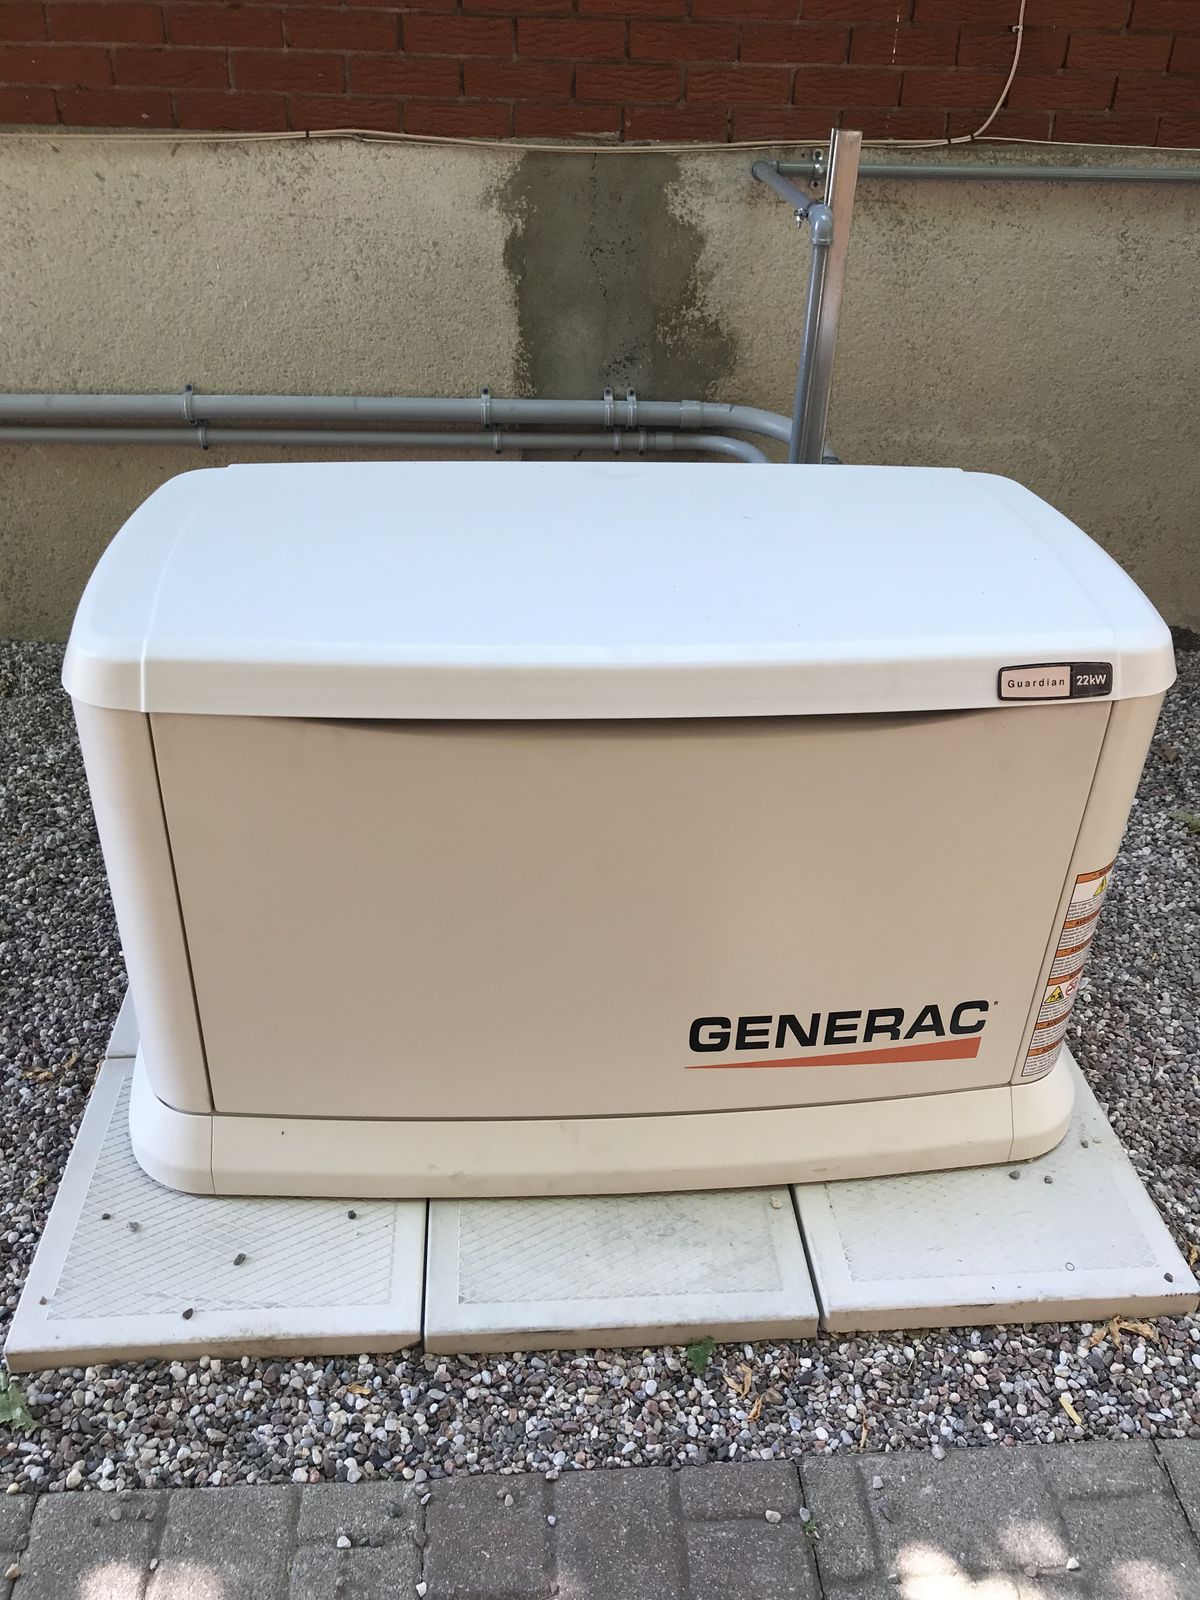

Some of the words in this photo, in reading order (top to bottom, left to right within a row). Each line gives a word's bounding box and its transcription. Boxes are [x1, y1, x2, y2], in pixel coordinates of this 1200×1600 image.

[1007, 679, 1065, 688] Guardian
[1076, 675, 1107, 686] 22kW
[689, 1000, 990, 1053] GENERAC
